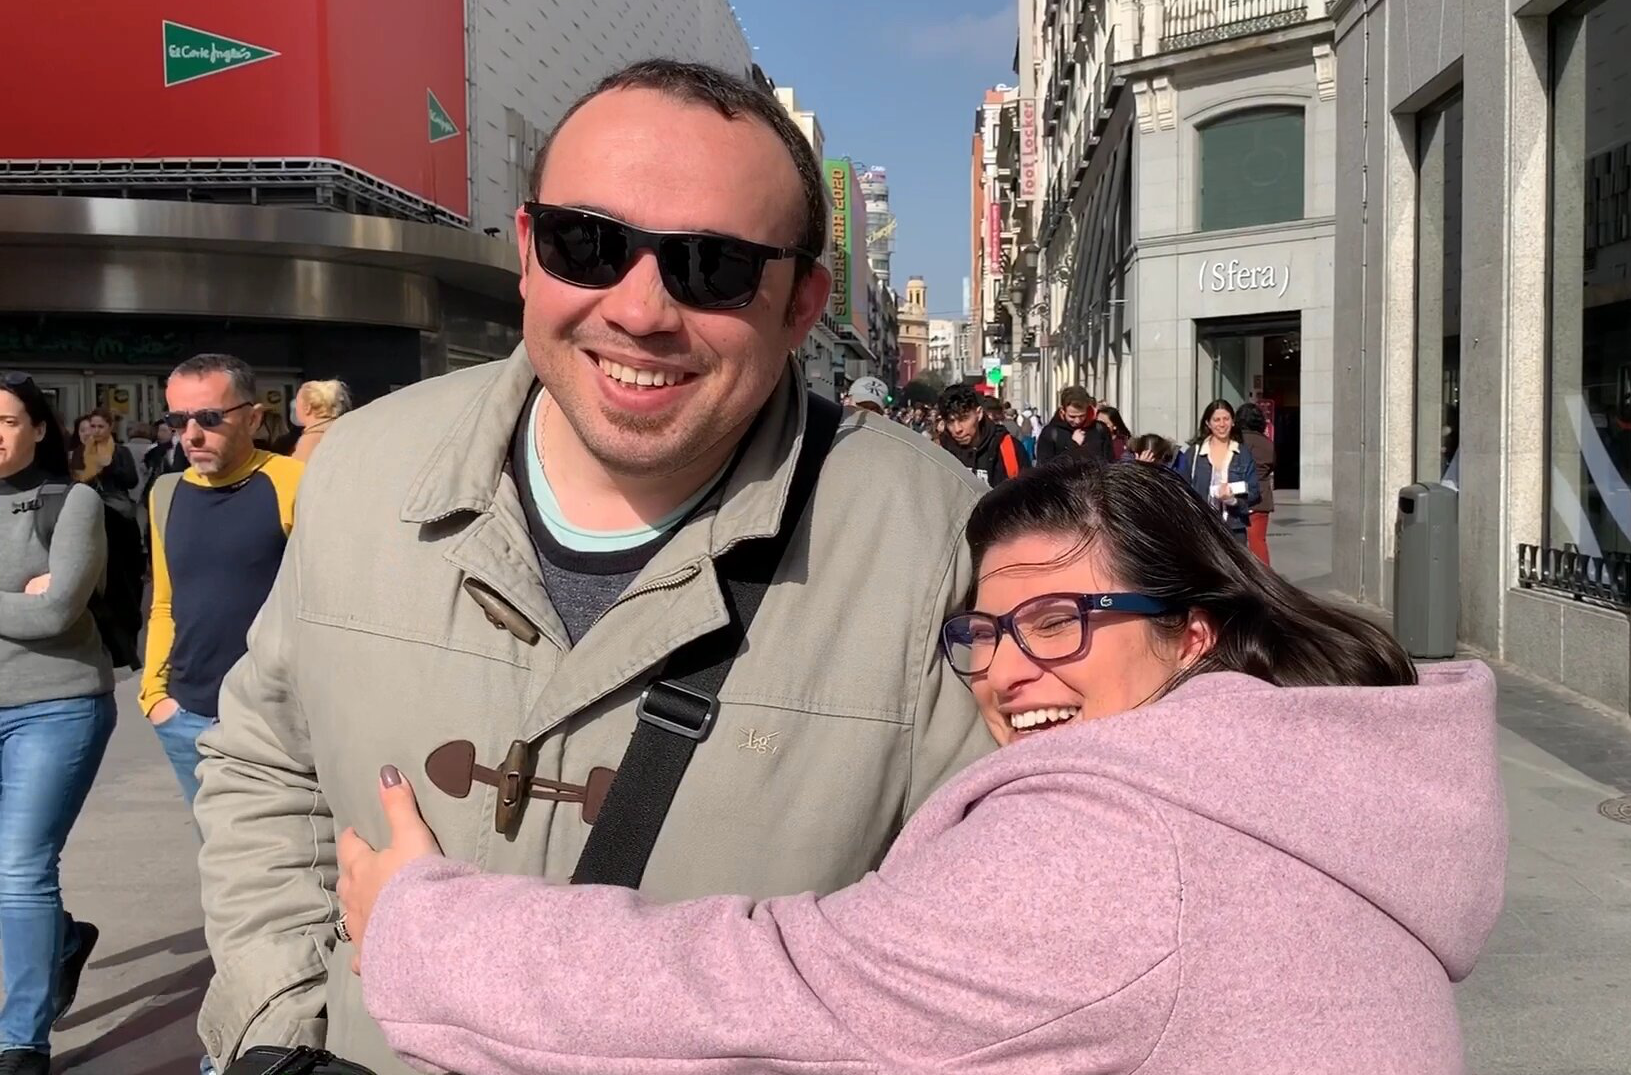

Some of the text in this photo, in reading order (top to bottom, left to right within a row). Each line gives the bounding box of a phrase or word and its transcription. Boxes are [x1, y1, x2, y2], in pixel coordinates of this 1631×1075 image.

[168, 44, 181, 58] El
[181, 45, 209, 58] Corte
[1022, 101, 1035, 196] Foot Locker
[832, 168, 846, 210] 2020
